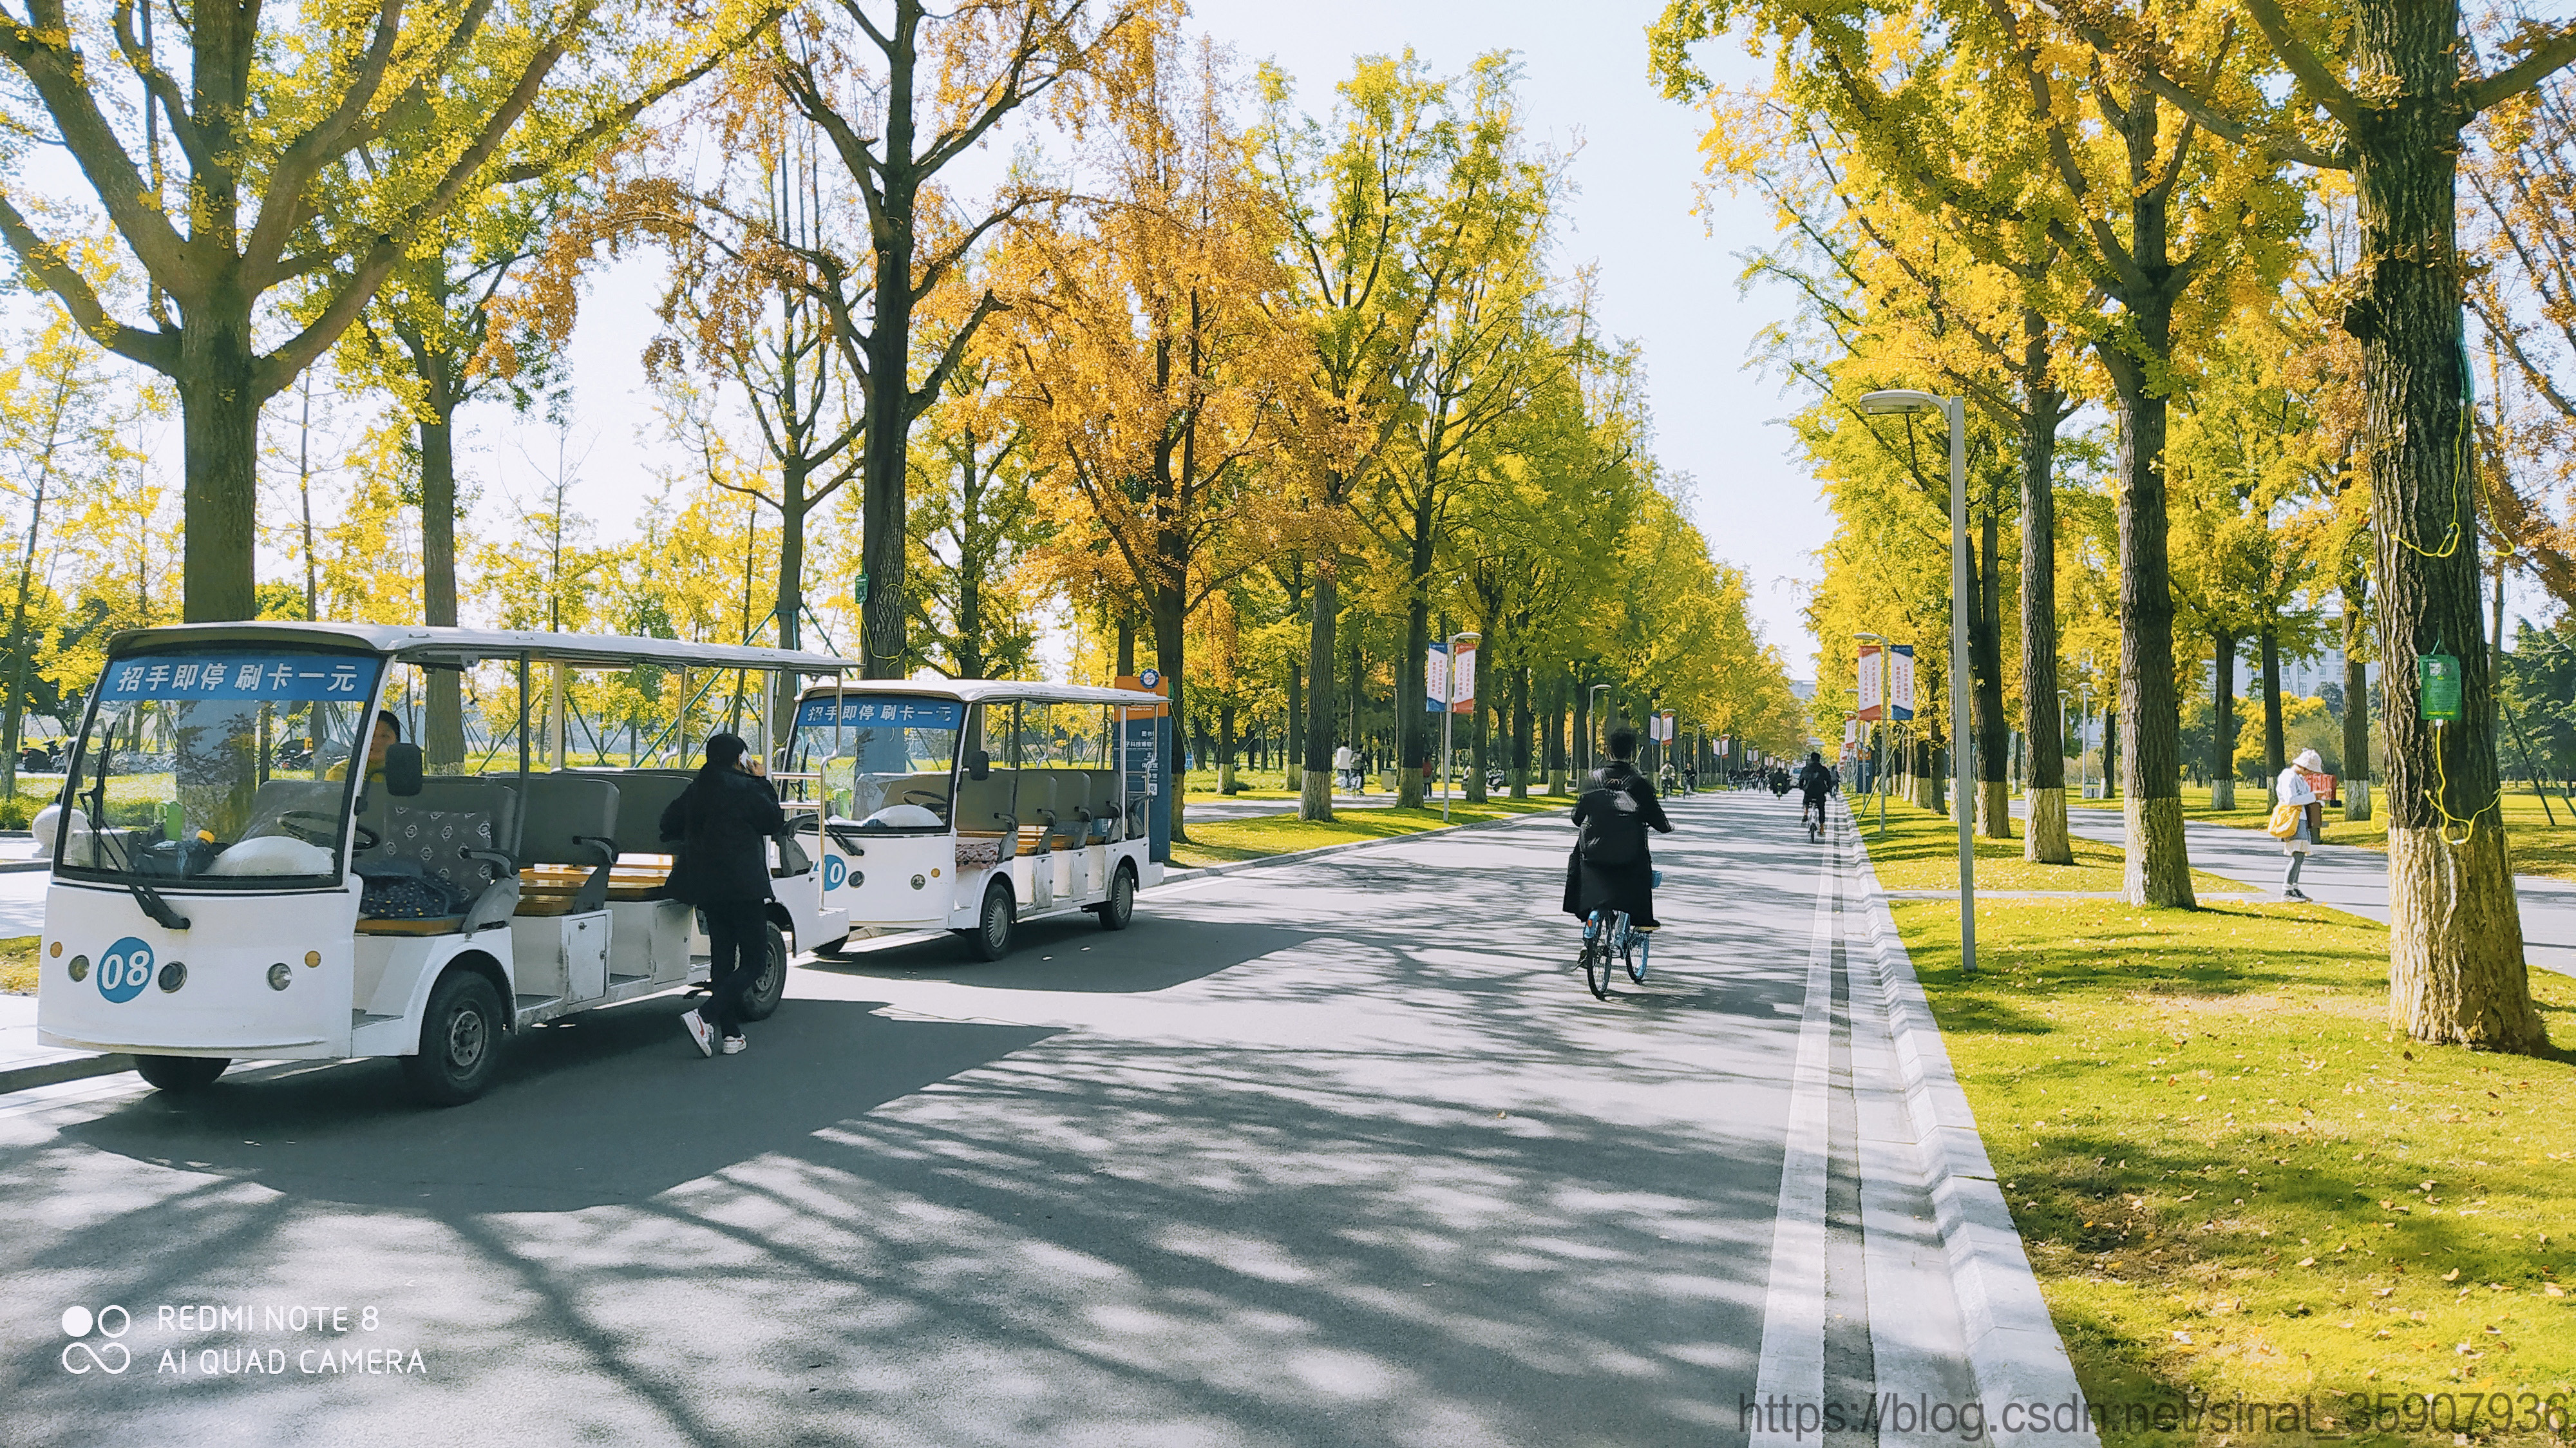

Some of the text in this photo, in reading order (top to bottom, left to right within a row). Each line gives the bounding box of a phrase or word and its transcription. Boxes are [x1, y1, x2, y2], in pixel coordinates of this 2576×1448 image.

[117, 663, 357, 692] 招手即停 刷卡一元
[808, 704, 875, 721] 招手即停
[102, 950, 150, 990] 08
